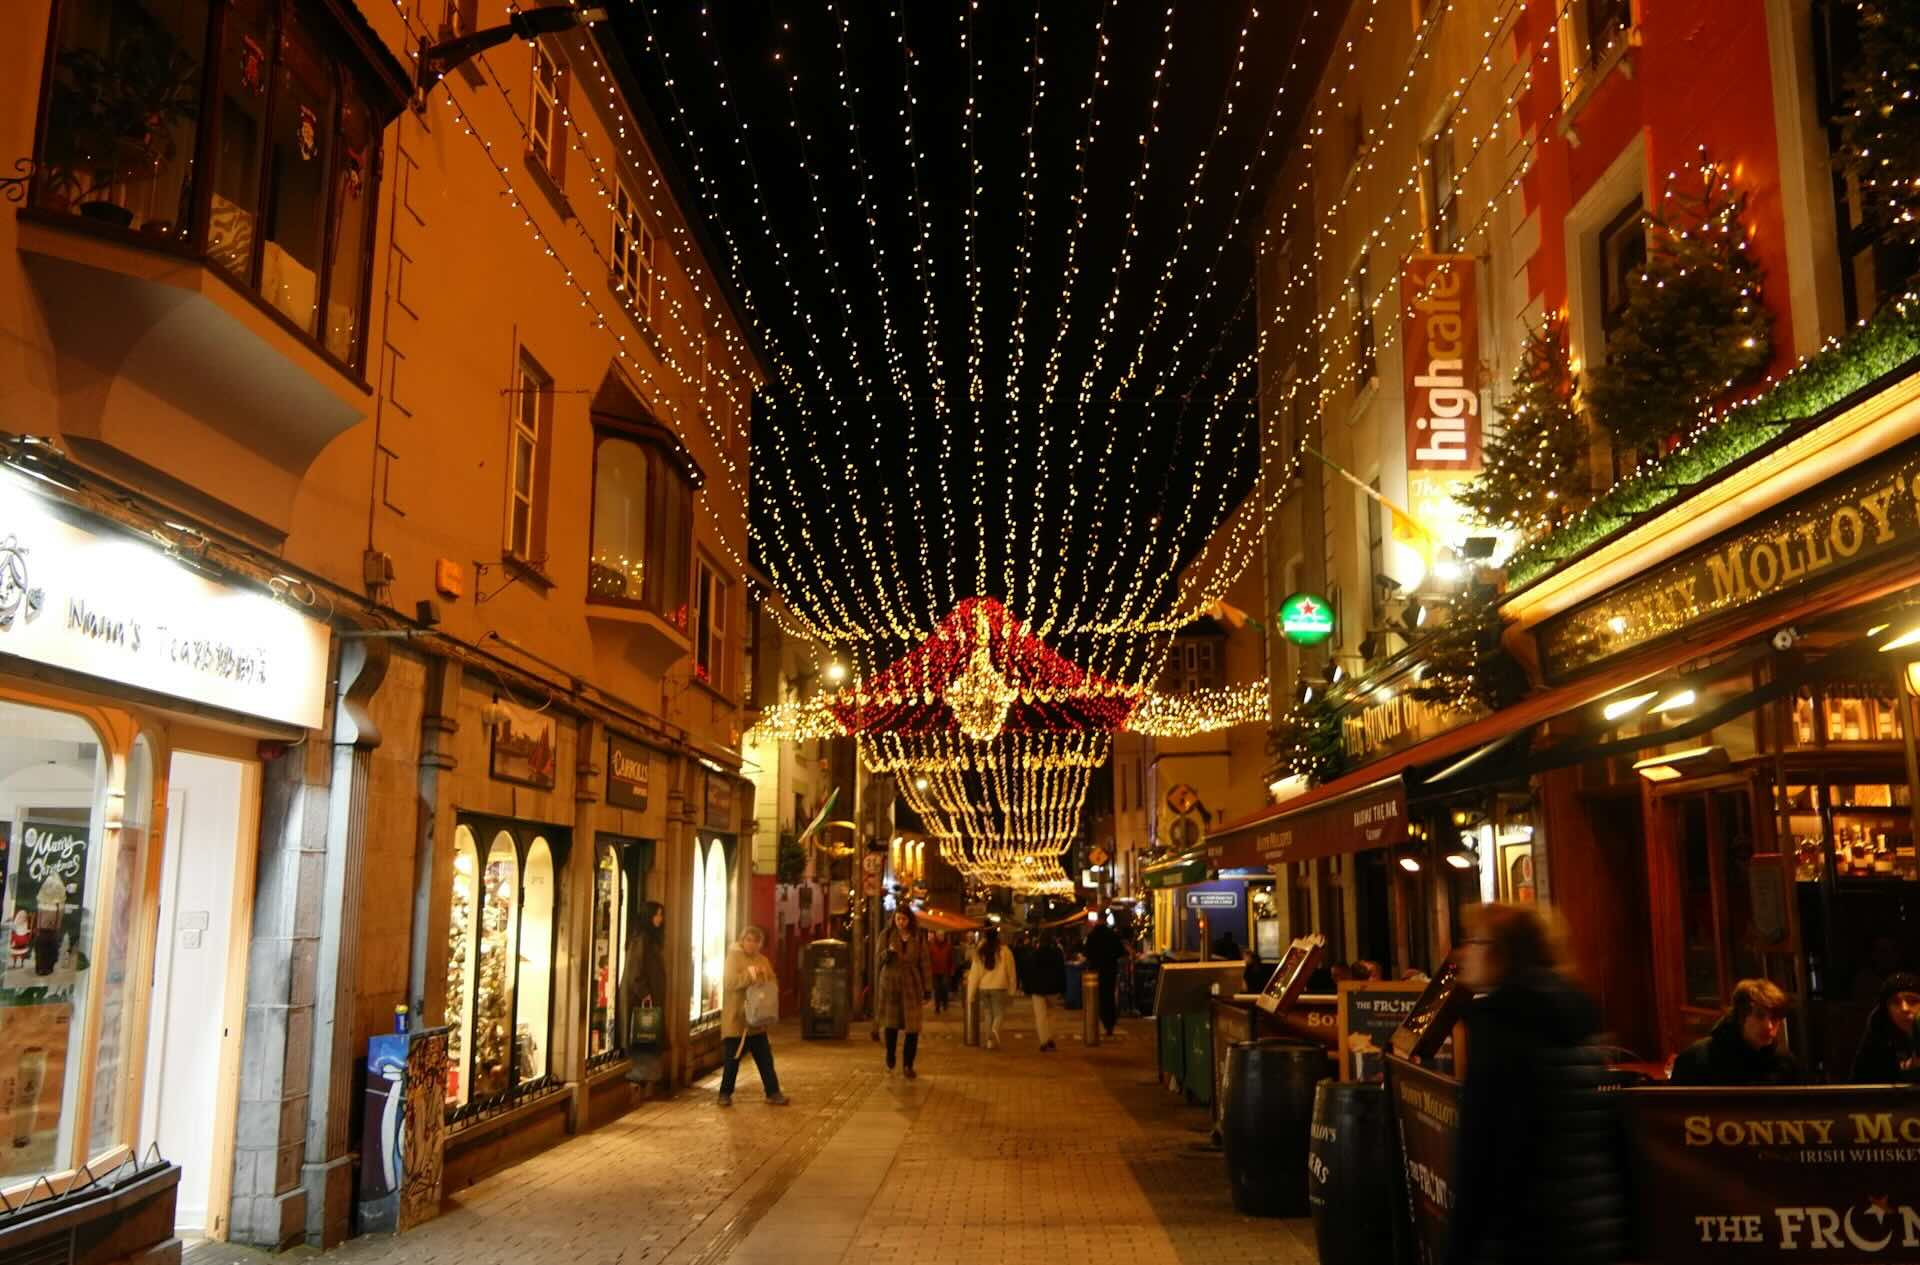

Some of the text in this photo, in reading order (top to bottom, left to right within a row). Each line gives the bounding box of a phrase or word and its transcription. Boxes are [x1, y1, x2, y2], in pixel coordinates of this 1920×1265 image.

[1307, 1012, 1337, 1027] SO
[1684, 1114, 1834, 1146] SONNY
[1800, 1149, 1845, 1164] IRISH
[1848, 1147, 1920, 1163] WHISKE
[1695, 1215, 1765, 1243] THE
